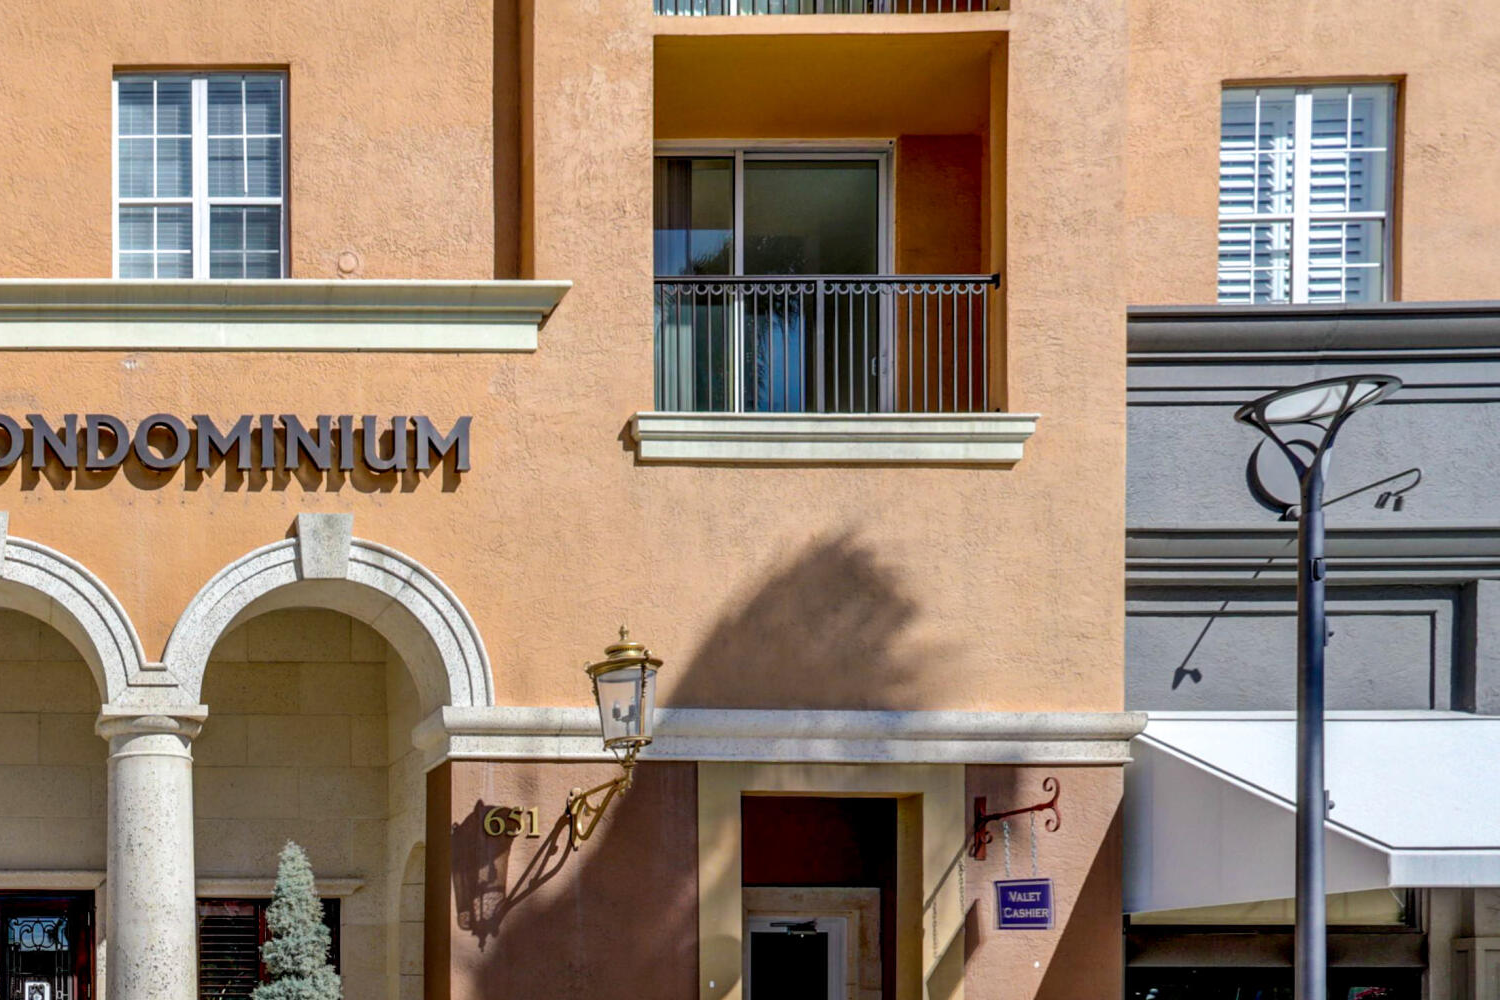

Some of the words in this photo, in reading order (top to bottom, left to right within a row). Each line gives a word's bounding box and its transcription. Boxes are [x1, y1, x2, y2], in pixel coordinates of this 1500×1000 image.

[484, 806, 541, 837] 651
[1008, 891, 1042, 902] VALET
[1003, 907, 1049, 919] CASHIER
